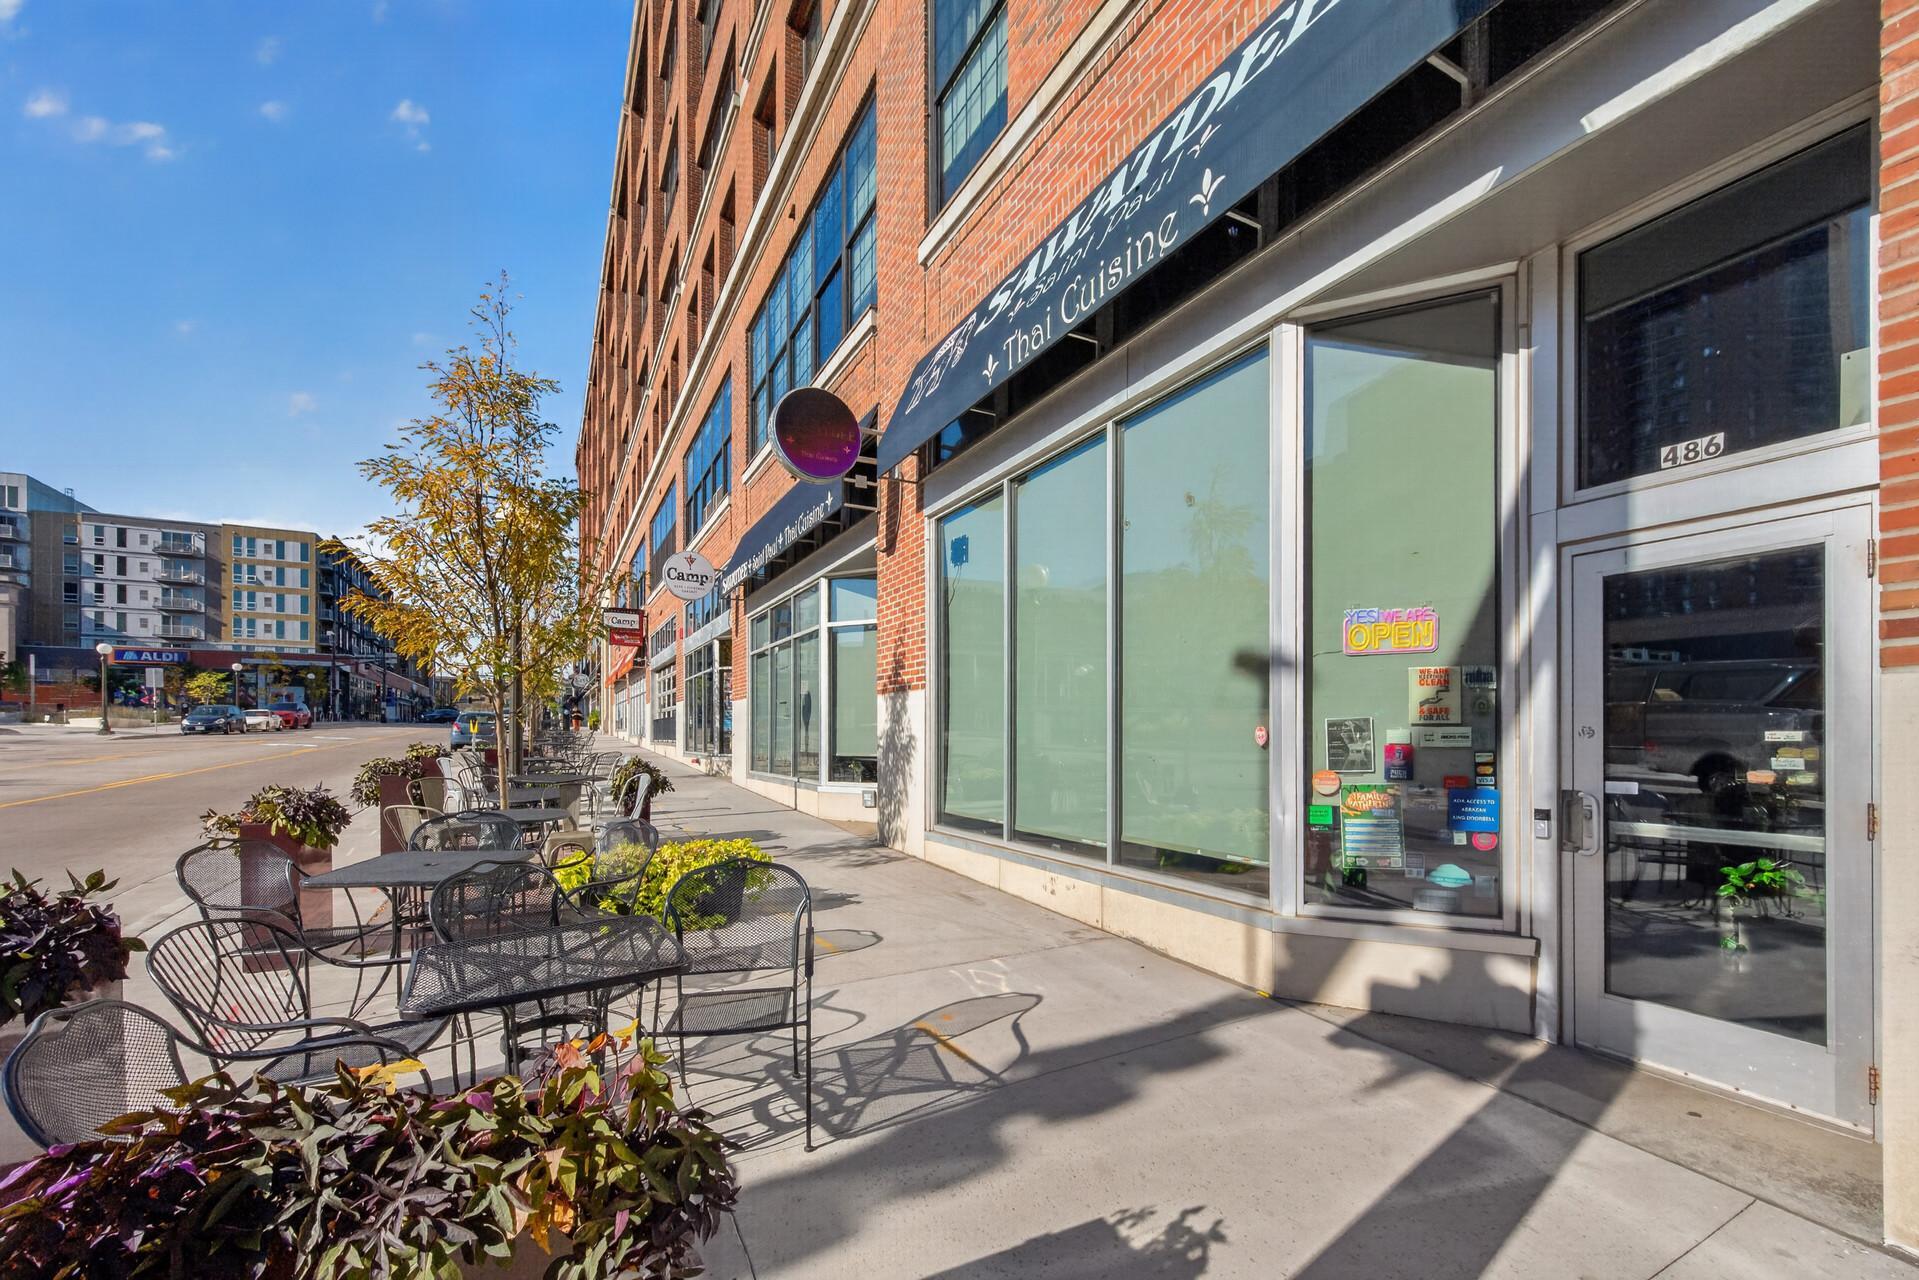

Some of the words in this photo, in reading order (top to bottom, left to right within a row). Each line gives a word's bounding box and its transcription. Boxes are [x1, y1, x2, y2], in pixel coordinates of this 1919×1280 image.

[1026, 231, 1096, 308] Saint
[1003, 306, 1051, 371] Thai
[1061, 211, 1179, 324] Cuisine
[1662, 434, 1722, 466] 486
[784, 520, 798, 545] Thai
[798, 503, 825, 534] Cuisine
[667, 567, 709, 586] Camp
[611, 616, 636, 627] Camp
[1382, 609, 1402, 622] WE
[1348, 621, 1433, 651] OPEN
[141, 651, 179, 662] ALDI
